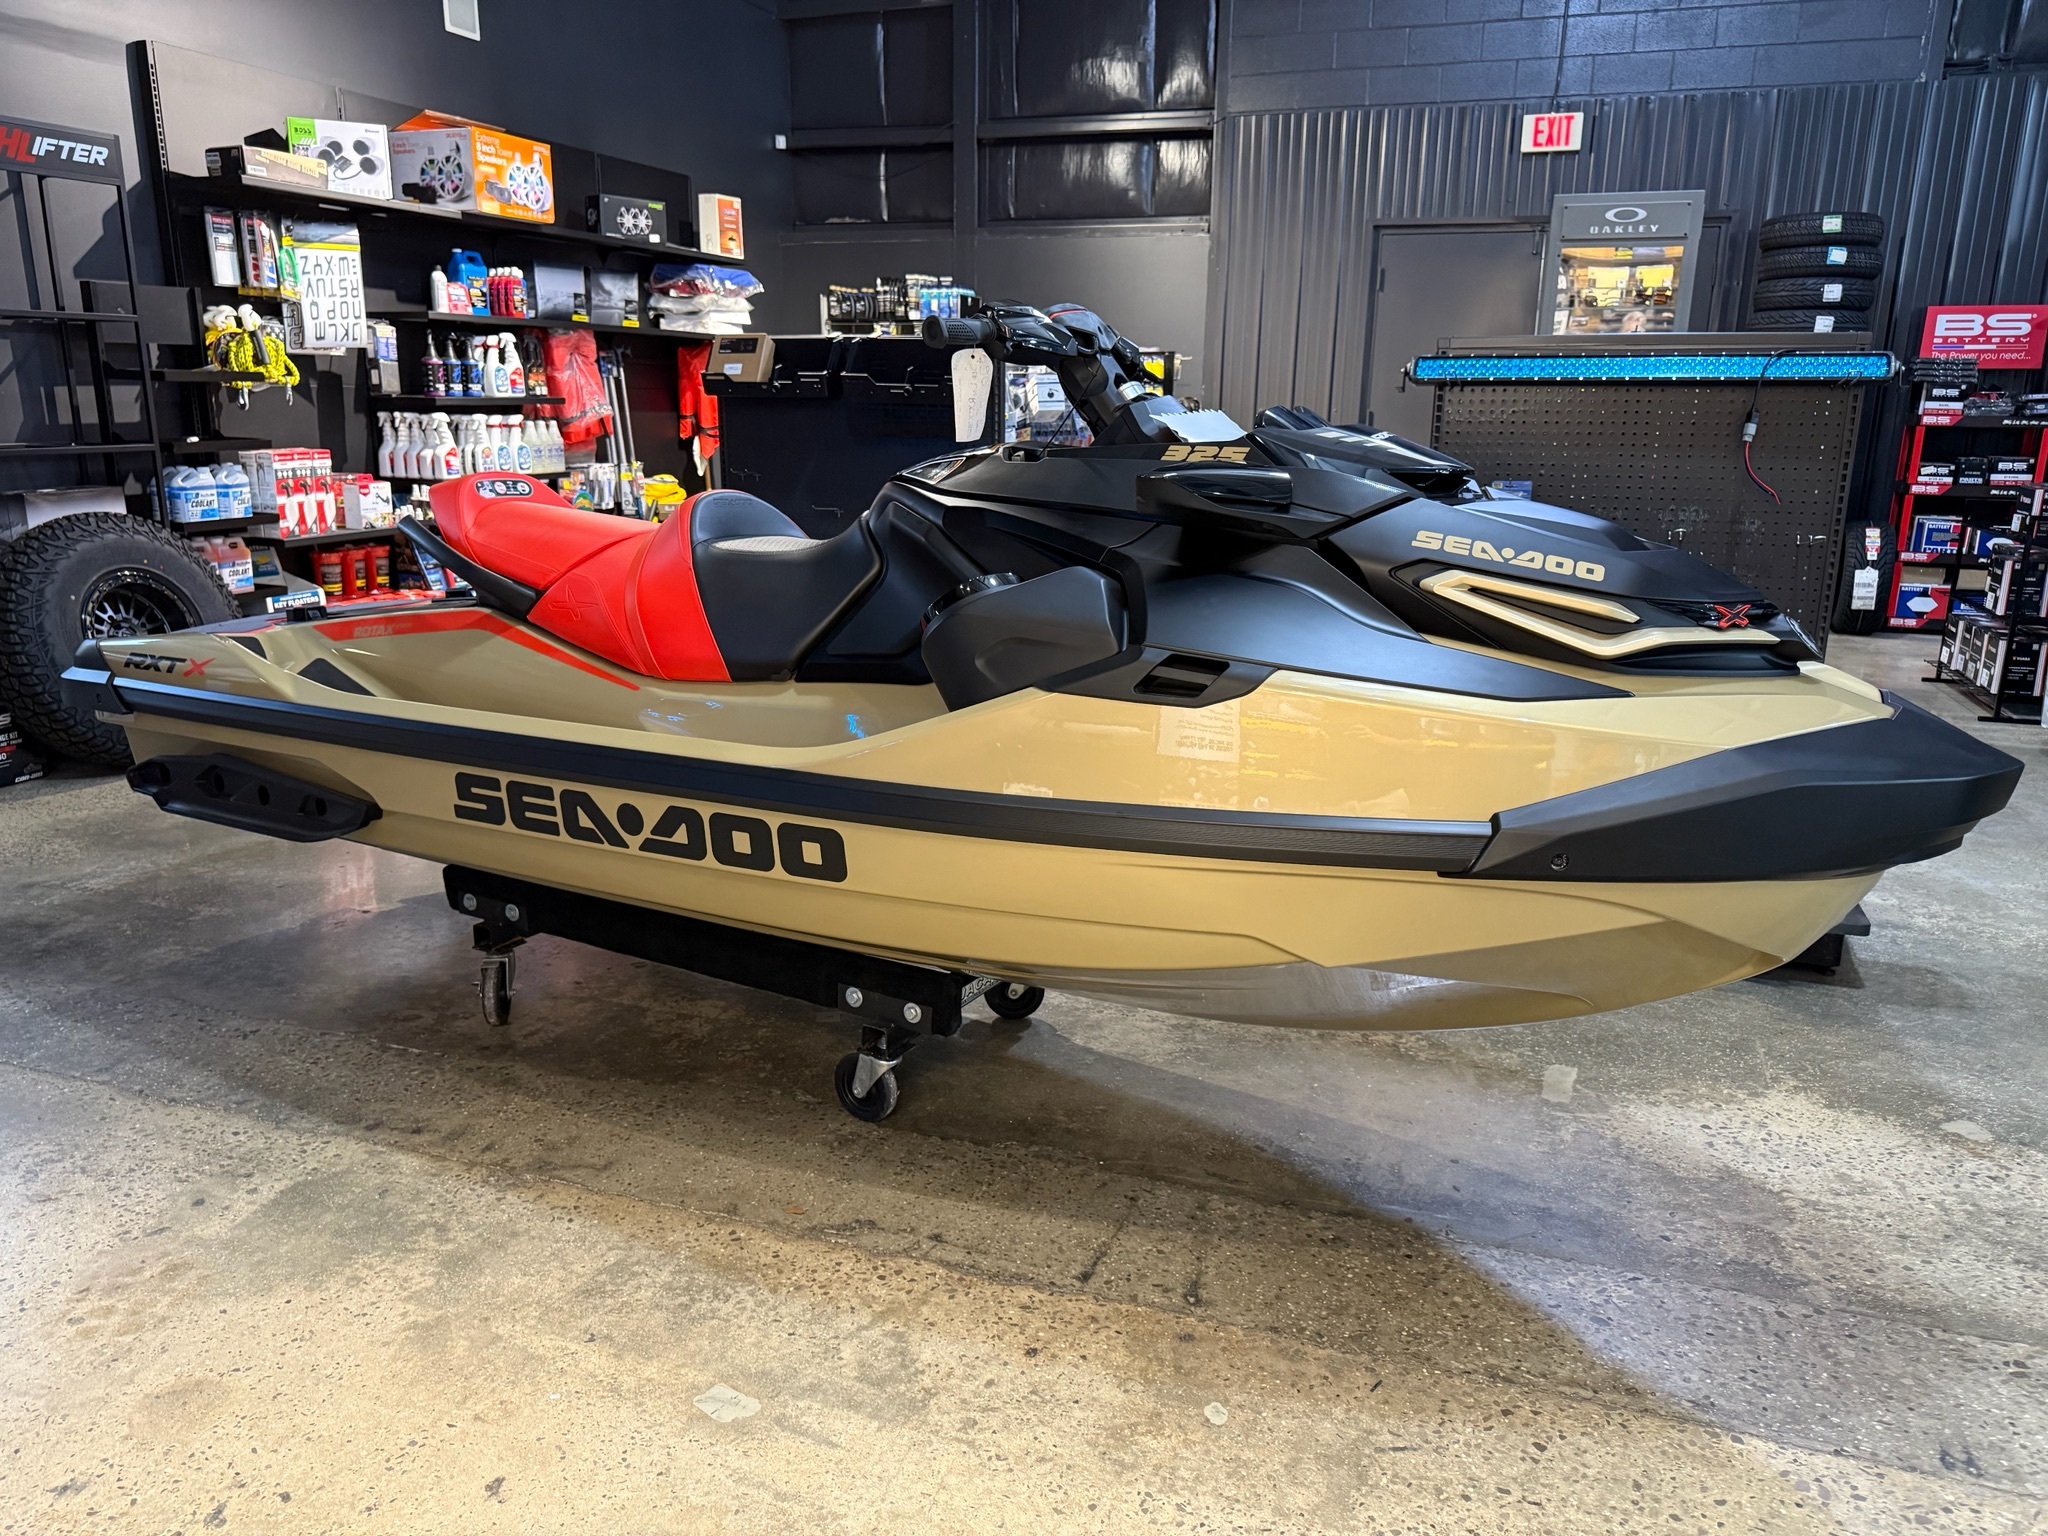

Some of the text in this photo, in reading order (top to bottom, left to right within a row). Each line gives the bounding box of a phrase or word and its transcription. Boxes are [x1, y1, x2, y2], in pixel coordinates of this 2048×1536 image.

[1533, 115, 1575, 147] EXIT
[482, 144, 496, 154] inch
[476, 152, 507, 166] Speakers
[1590, 224, 1659, 235] OAKLEY
[1934, 313, 2032, 336] BS
[1931, 351, 1947, 360] The
[1980, 353, 1998, 362] you
[1999, 351, 2031, 360] need...
[1932, 388, 1960, 396] BS
[1160, 445, 1251, 464] 325
[1998, 462, 2028, 470] BS
[191, 499, 215, 508] COOLANT
[229, 568, 250, 577] COOLANT
[274, 600, 287, 609] KEY
[288, 596, 319, 607] FLOATERS
[354, 623, 395, 638] ROTAX
[124, 652, 187, 670] RXT
[10, 731, 18, 740] KIT
